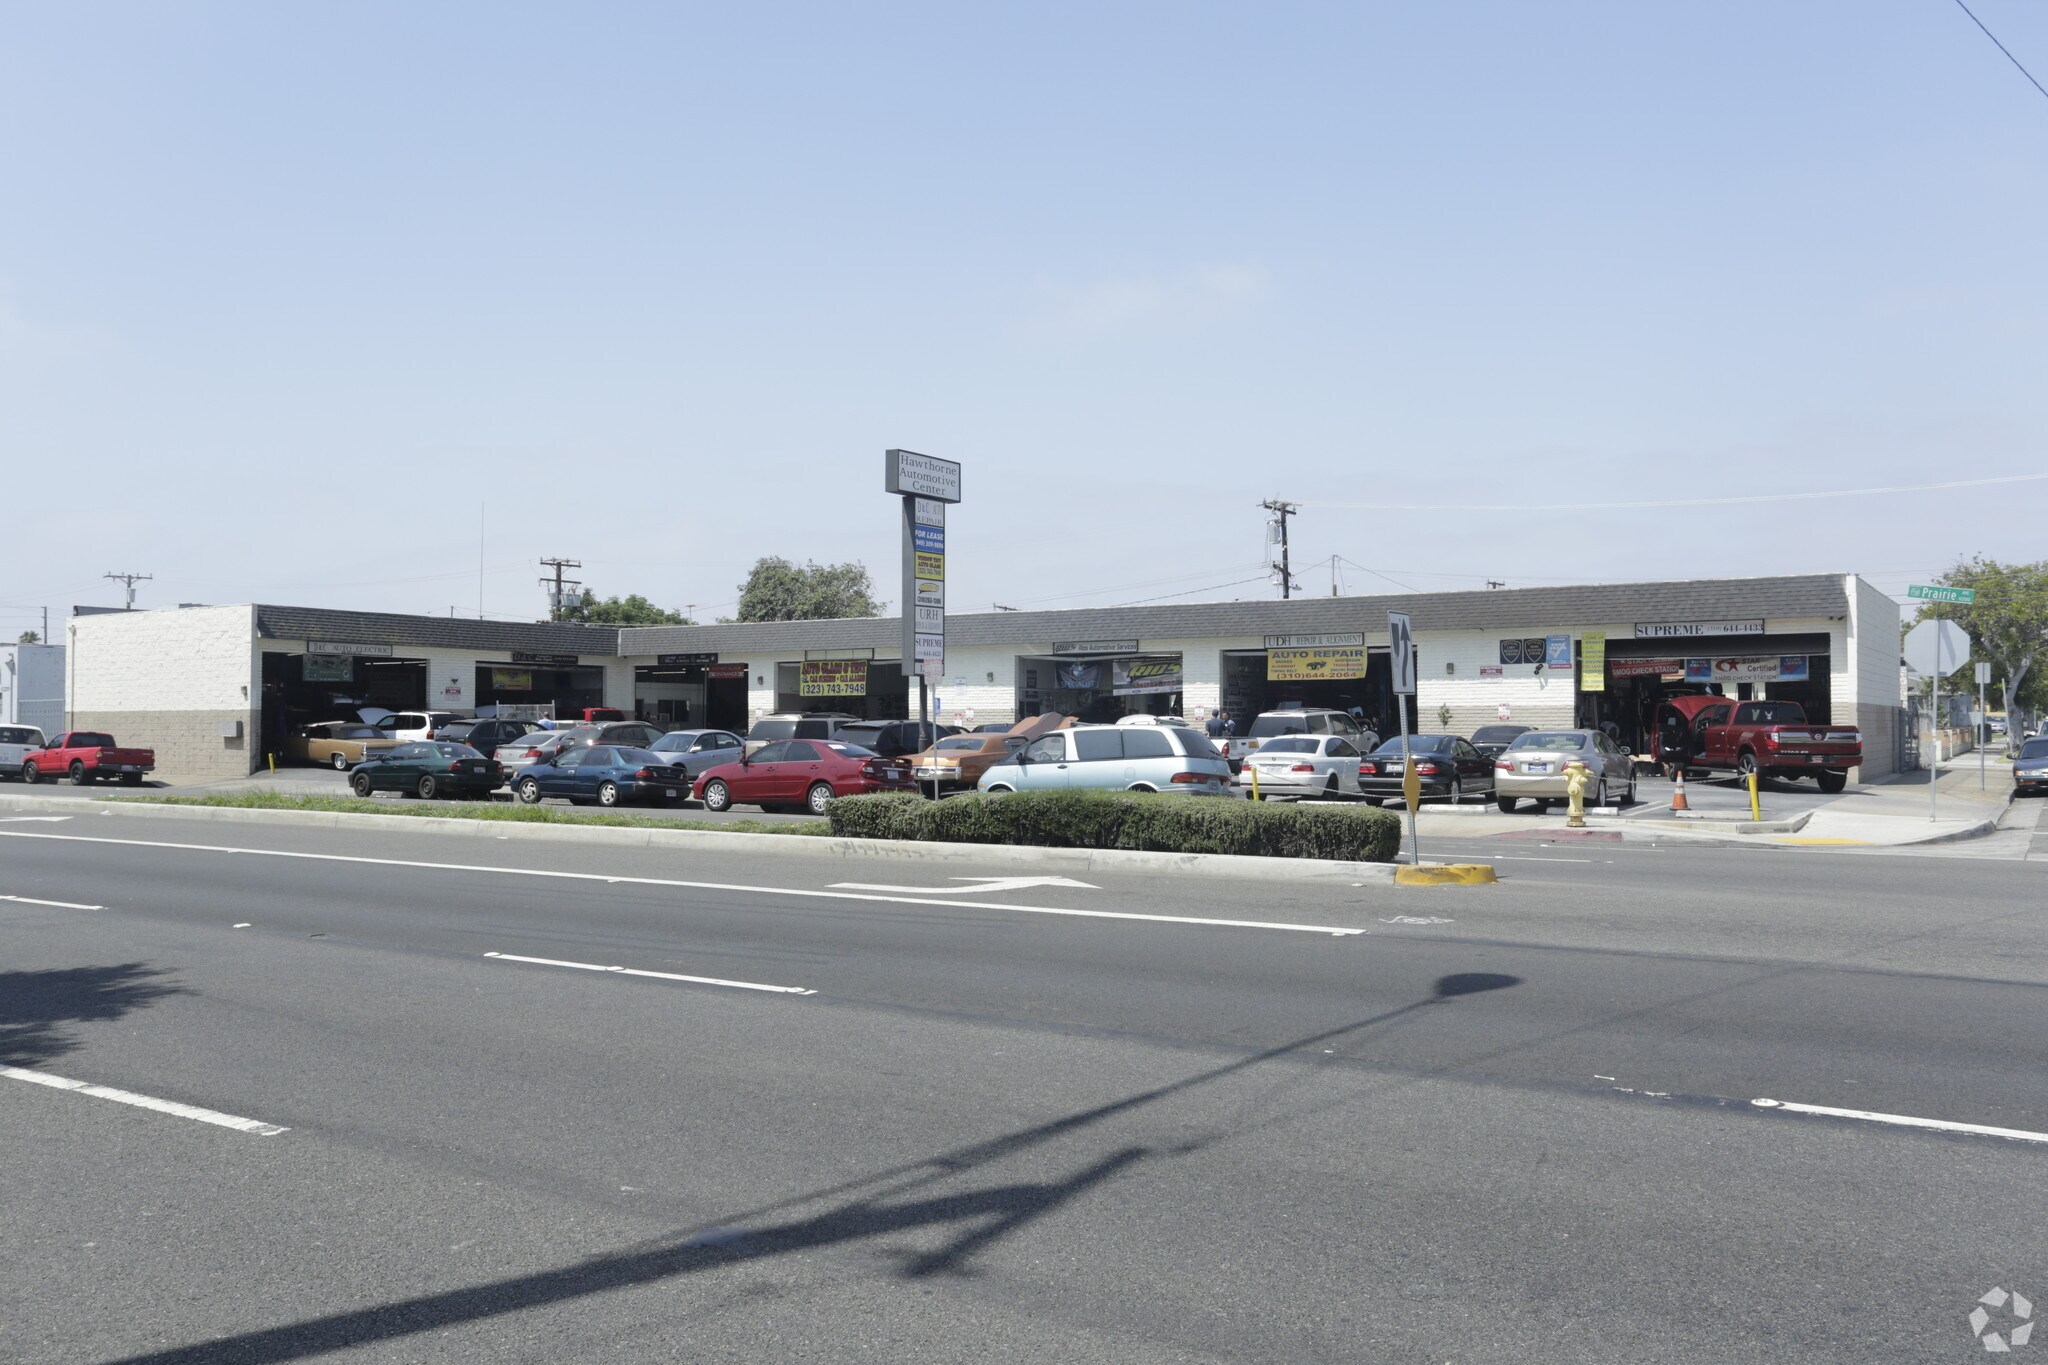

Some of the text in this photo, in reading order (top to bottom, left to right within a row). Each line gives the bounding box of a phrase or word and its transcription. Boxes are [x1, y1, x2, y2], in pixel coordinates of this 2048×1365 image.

[901, 455, 956, 475] Hawthorne
[900, 468, 956, 487] Automotive
[913, 480, 946, 495] Center
[915, 529, 943, 540] FOR LEASE
[1922, 587, 1957, 600] Prairie
[920, 609, 938, 620] URH
[1636, 624, 1704, 637] SUPREME
[1723, 623, 1764, 633] 644-4433
[916, 639, 943, 648] SUPREME
[1268, 635, 1361, 646] UDH REPAIR & ALIGNMENT
[1272, 650, 1364, 659] AUTO REPAIR
[802, 684, 864, 695] (323) 743-7948
